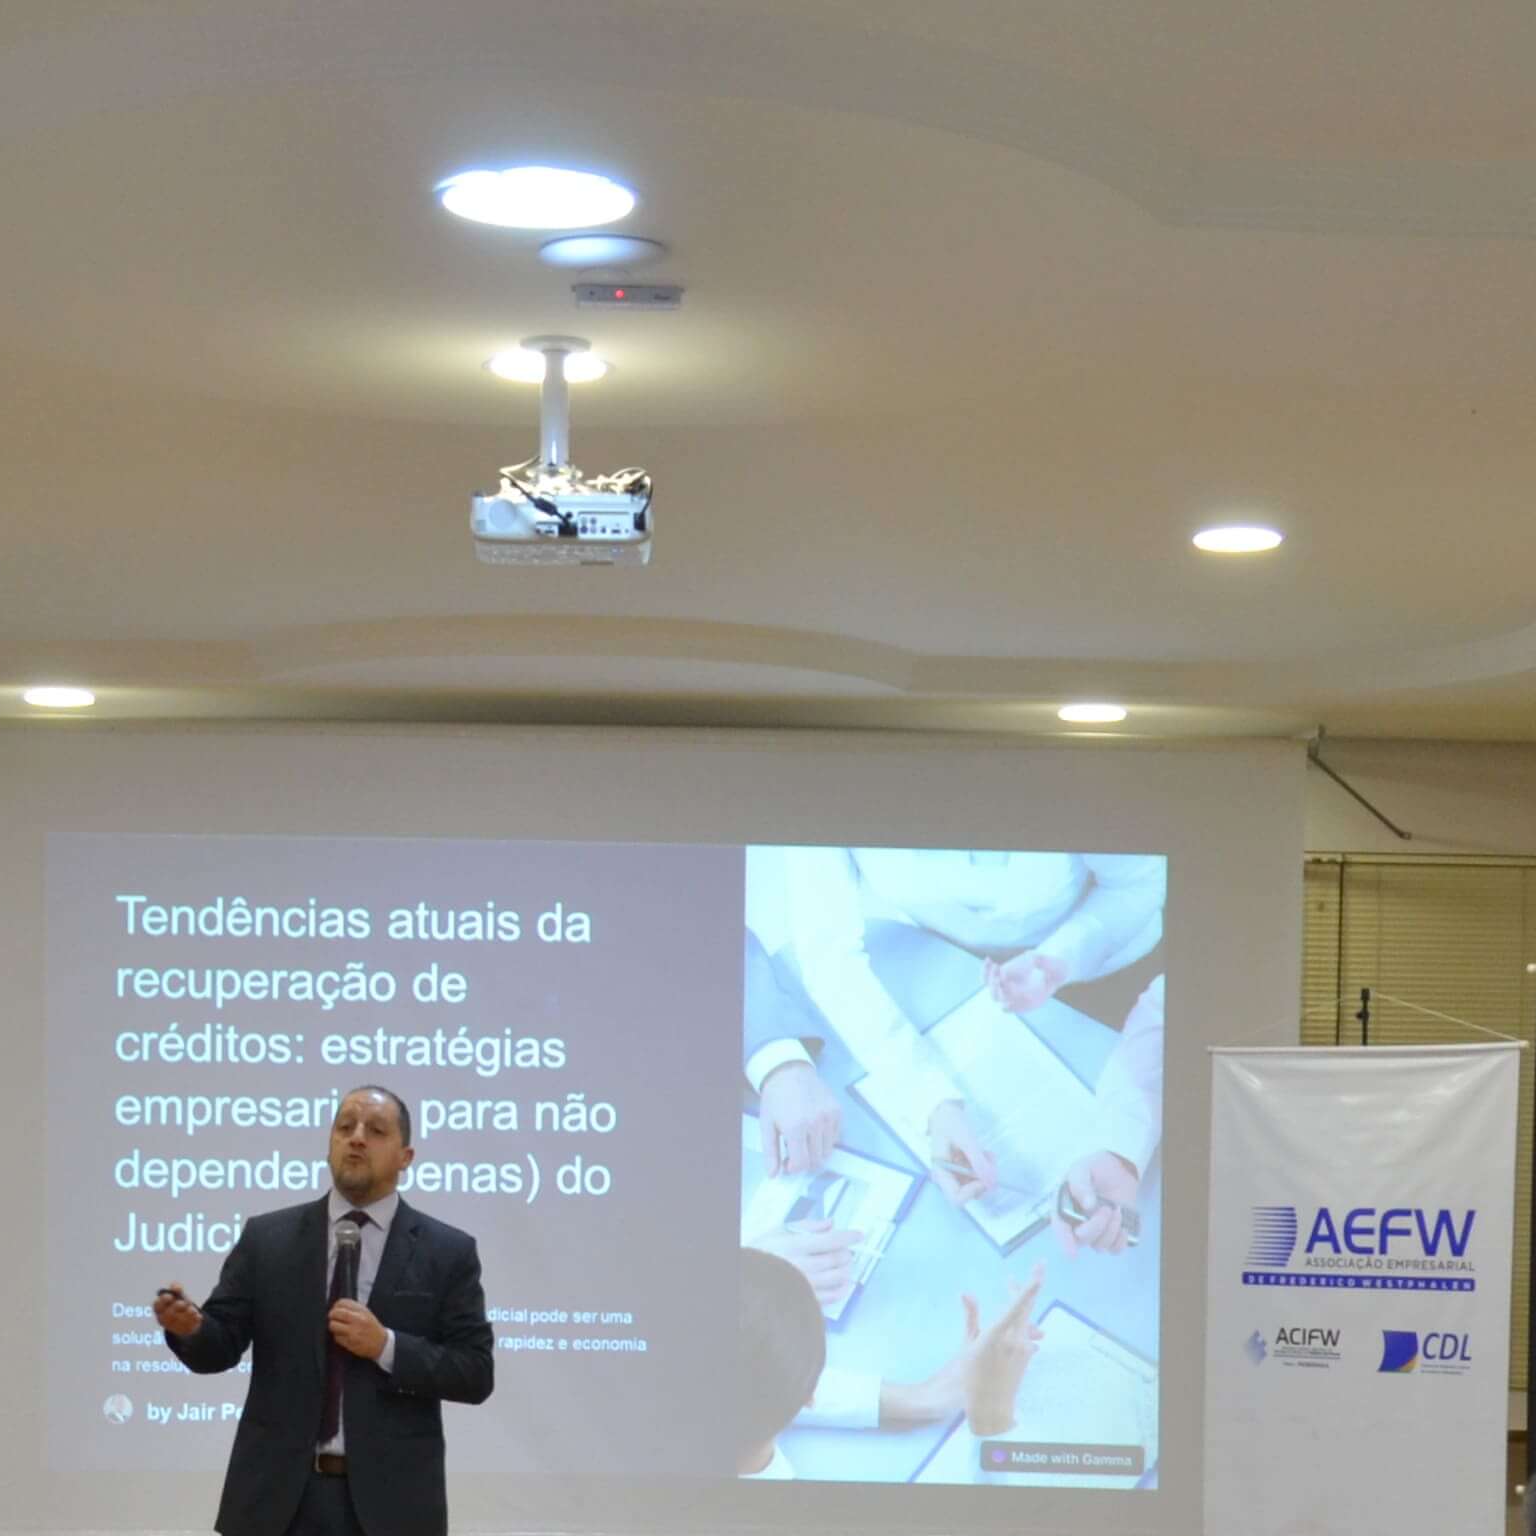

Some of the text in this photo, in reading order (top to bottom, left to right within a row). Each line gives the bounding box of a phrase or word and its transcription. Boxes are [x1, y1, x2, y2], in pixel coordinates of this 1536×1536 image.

[116, 896, 592, 943] Tendências atuais da
[116, 962, 467, 1009] recuperação de
[115, 1024, 566, 1077] créditos: estratégias
[115, 1090, 617, 1138] empresari para não
[114, 1150, 328, 1198] depender
[556, 1156, 611, 1195] do
[114, 1213, 242, 1253] Judici
[1304, 1206, 1476, 1257] AEFW
[1305, 1256, 1476, 1272] ASSOCIAÇÃO EMPRESARIAL
[1248, 1274, 1472, 1290] DE FREDERICO WESTPHALEN
[530, 1309, 568, 1326] pode
[573, 1311, 598, 1323] ser
[601, 1311, 633, 1324] uma
[112, 1331, 647, 1352] soluçã rapidez e economia
[1275, 1327, 1341, 1347] ACIFW
[1422, 1331, 1472, 1361] CDL
[112, 1360, 131, 1372] na
[147, 1402, 172, 1423] by
[177, 1402, 216, 1420] Jair
[1011, 1451, 1132, 1466] Made with Gamma
